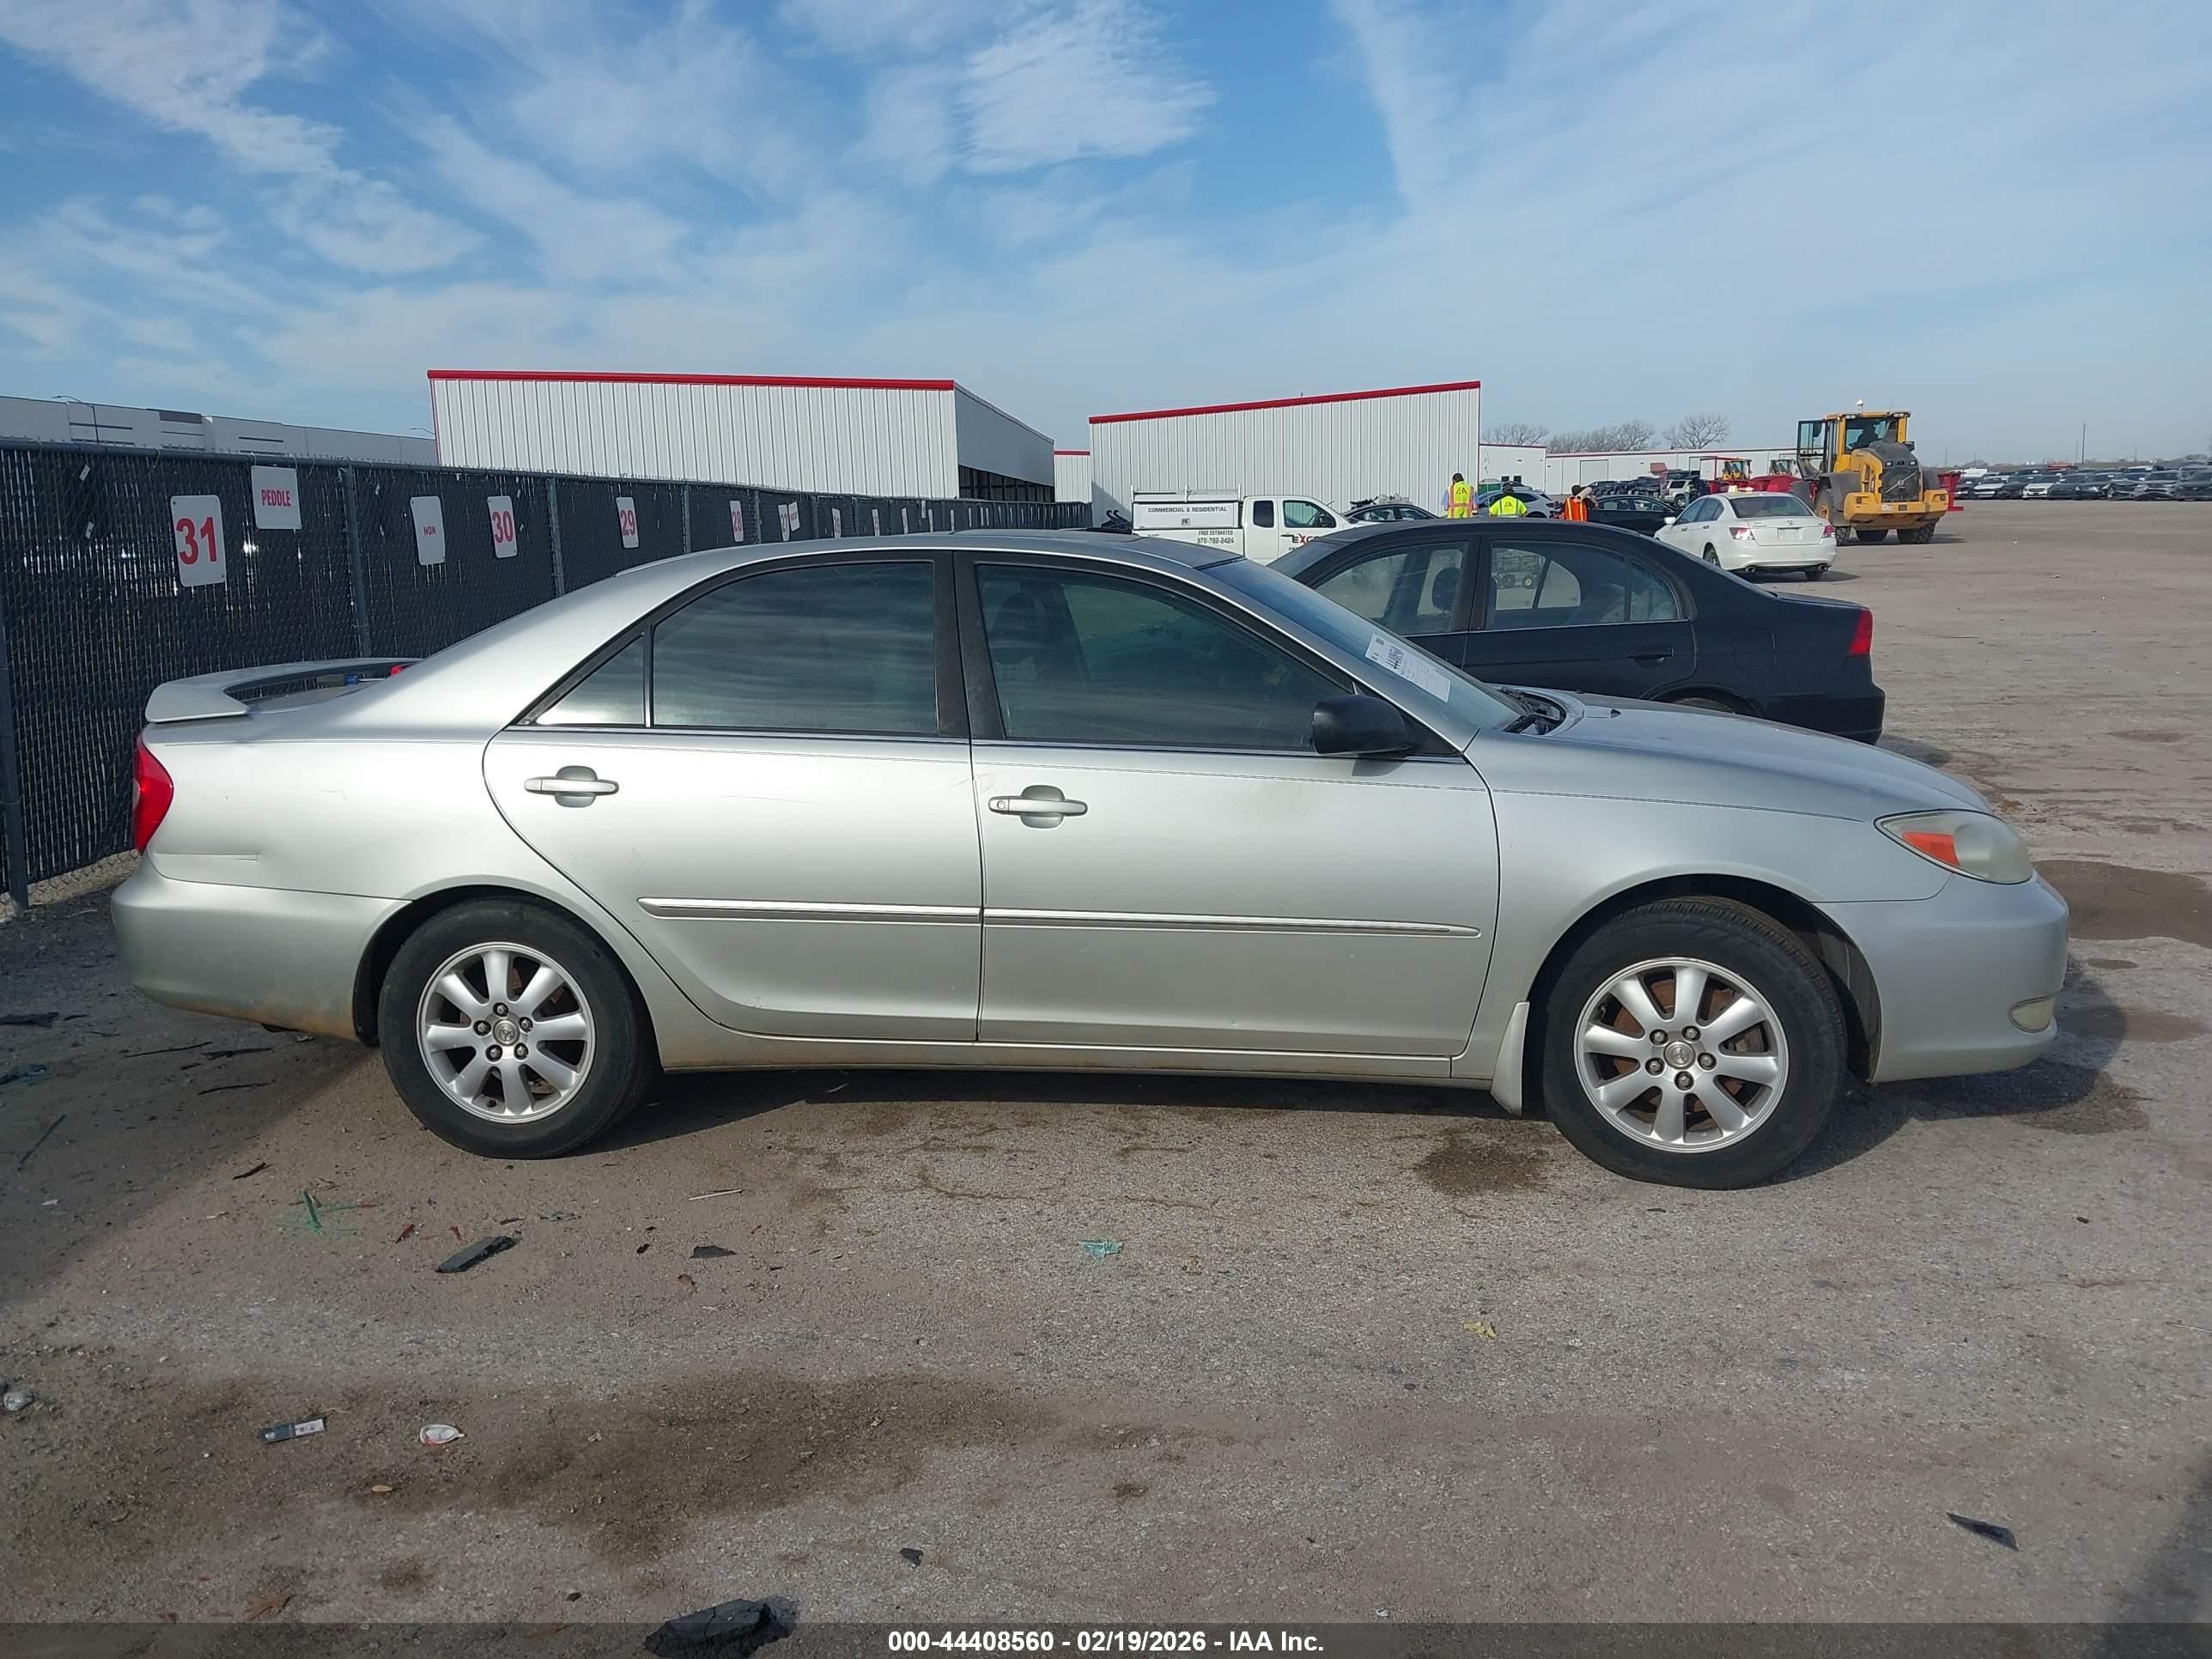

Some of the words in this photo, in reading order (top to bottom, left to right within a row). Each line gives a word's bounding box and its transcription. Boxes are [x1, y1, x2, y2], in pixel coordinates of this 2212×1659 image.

[261, 489, 291, 507] PEDDLE
[423, 525, 436, 536] NON
[492, 510, 514, 544] 30
[620, 509, 635, 537] 29
[732, 511, 742, 532] 28
[176, 517, 217, 564] 31
